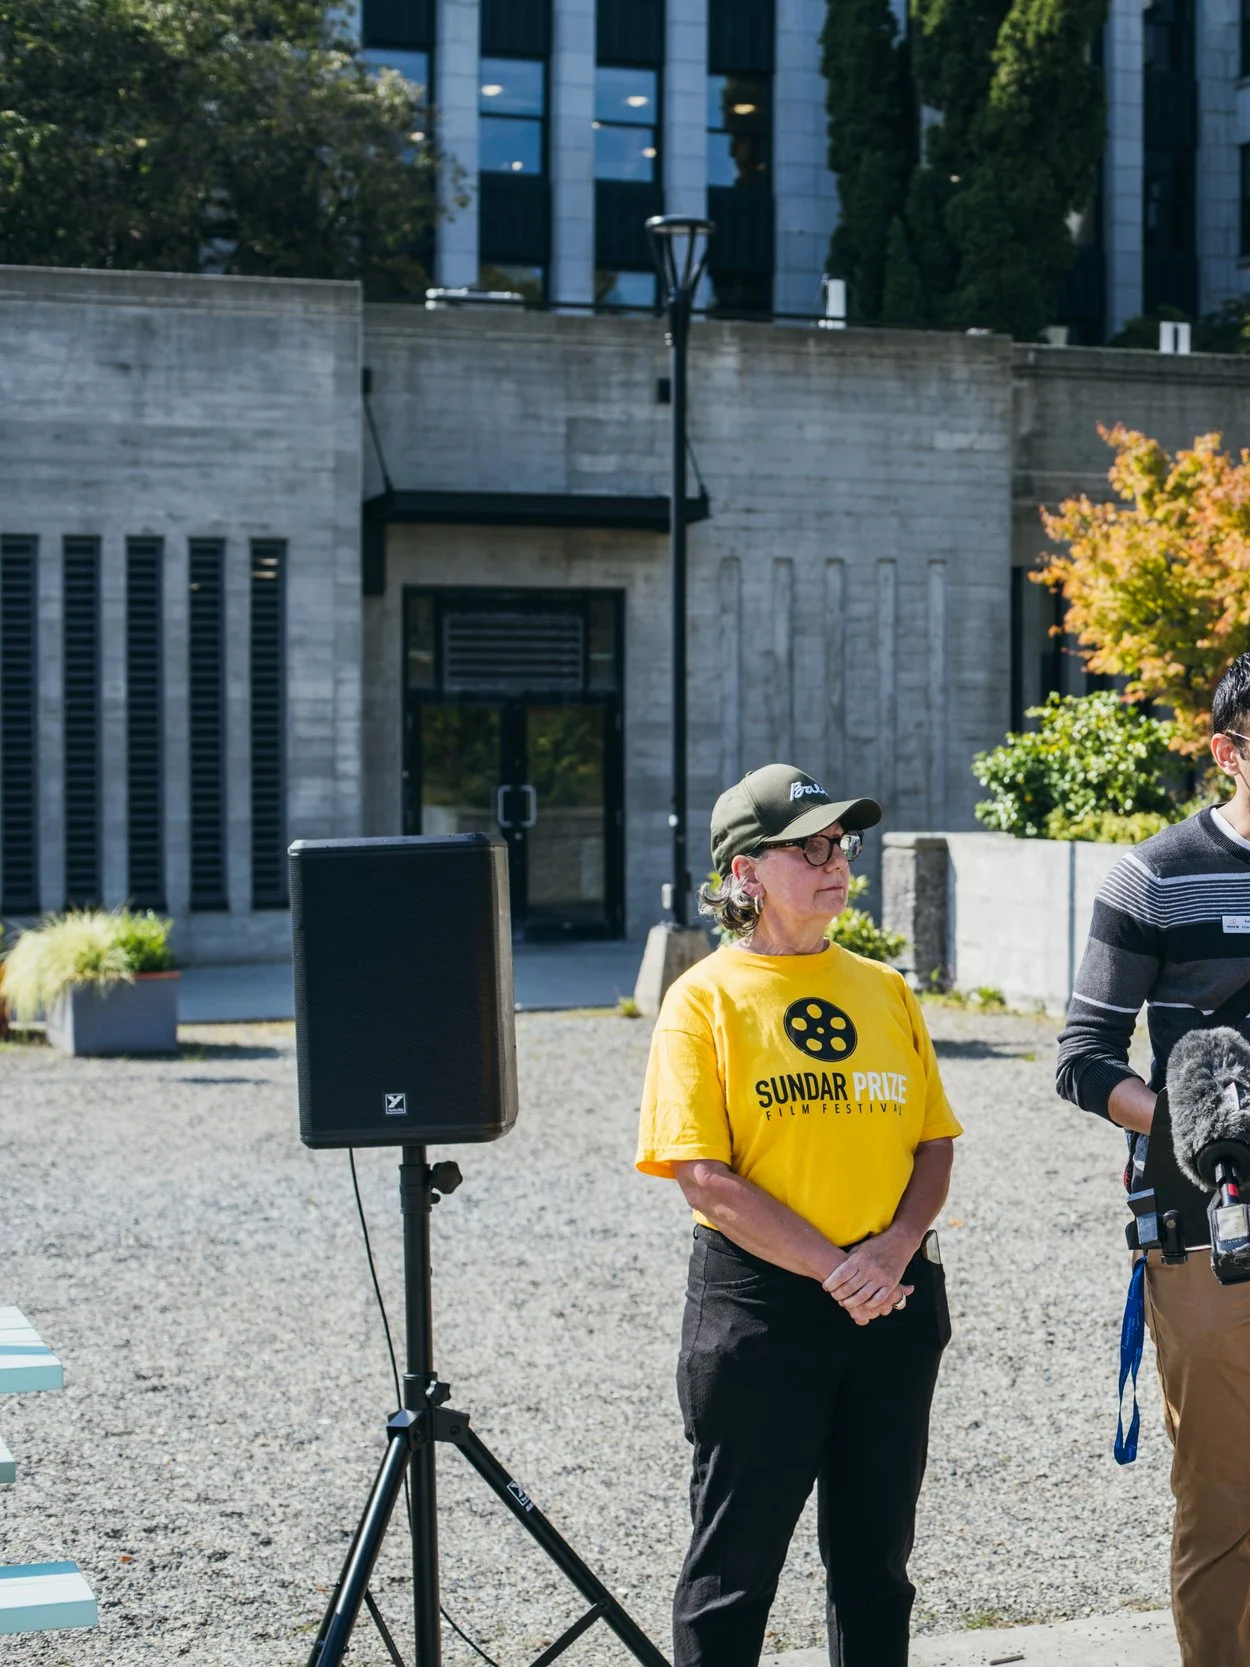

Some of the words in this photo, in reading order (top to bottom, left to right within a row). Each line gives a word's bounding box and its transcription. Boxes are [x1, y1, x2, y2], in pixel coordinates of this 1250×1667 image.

[755, 1072, 848, 1109] SUNDAR
[852, 1071, 907, 1105] PRIZE
[766, 1103, 810, 1121] FILM
[822, 1103, 902, 1116] FESTIVAL
